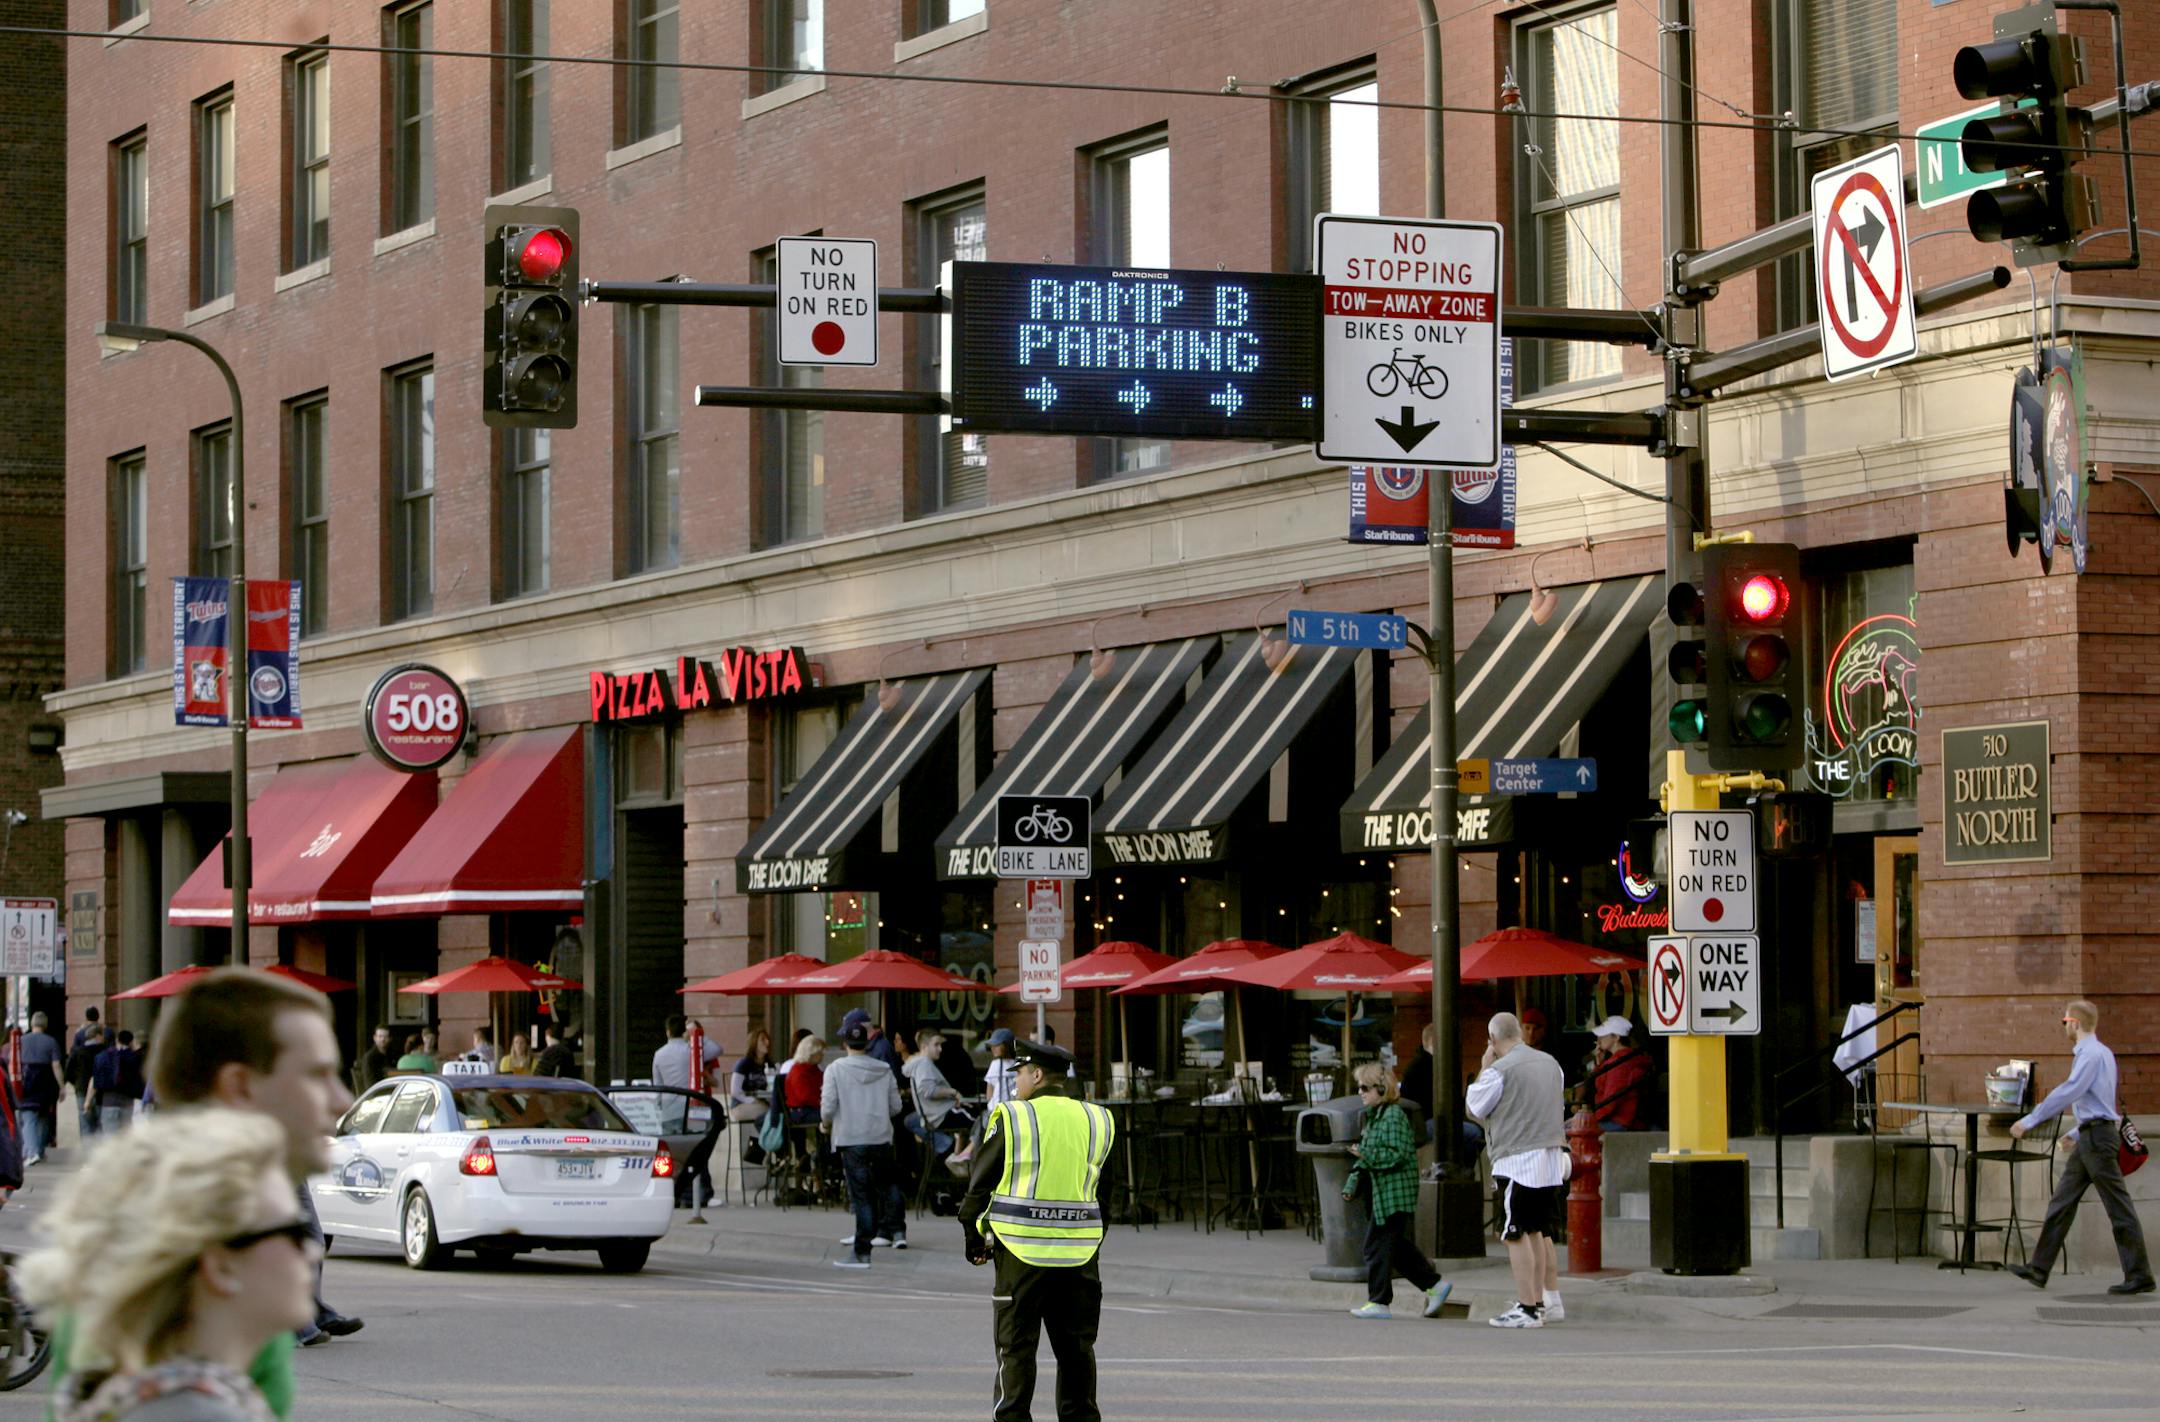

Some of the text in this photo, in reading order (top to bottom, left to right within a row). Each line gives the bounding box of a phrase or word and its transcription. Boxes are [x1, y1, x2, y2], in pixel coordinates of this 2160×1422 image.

[1927, 143, 1943, 184] N
[1393, 232, 1426, 255] NO
[811, 247, 843, 266] NO
[800, 272, 855, 291] TURN
[1112, 271, 1169, 280] DAKTRONICS
[1346, 258, 1473, 285] STOPPING
[788, 296, 868, 316] ON RED
[1031, 279, 1249, 326] RAMP B
[1440, 296, 1486, 317] ZONE
[1345, 321, 1467, 344] BIKES ONLY
[1019, 324, 1260, 373] PARKING
[1502, 447, 1515, 523] ERRITORY
[1352, 482, 1366, 517] THIS
[1364, 529, 1415, 542] StarTribune
[1453, 533, 1501, 544] StarTribune
[1293, 617, 1400, 642] N 5th St
[409, 681, 430, 690] bar
[590, 646, 801, 723] PIZZA LA VISTA
[387, 693, 459, 732] 508
[388, 735, 454, 744] restaurant
[1869, 733, 1912, 759] LOON
[1983, 734, 2007, 758] 510
[1495, 762, 1538, 778] Target
[1815, 760, 1850, 781] THE
[1495, 777, 1543, 790] Center
[1953, 763, 2038, 803] BUTLER
[1364, 814, 1392, 847] THE
[1396, 811, 1432, 845] LOO
[1695, 820, 1729, 841] NO
[1956, 807, 2038, 846] NORTH
[1104, 830, 1213, 863] THE LOON CAFE
[948, 846, 998, 876] THE LOO
[1002, 852, 1085, 871] BIKE LANE
[1689, 849, 1736, 866] TURN
[748, 857, 829, 890] THE LOON CAFE
[1679, 875, 1747, 892] ON RED
[1597, 904, 1669, 933] Budweis
[1030, 949, 1049, 965] NO
[1700, 943, 1748, 965] ONE
[1023, 970, 1058, 982] PARKING
[1699, 970, 1749, 992] WAY
[453, 1064, 483, 1074] TAXI
[521, 1135, 532, 1145] &
[532, 1137, 562, 1145] White
[618, 1157, 653, 1169] 3117
[1029, 1207, 1088, 1222] TRAFFIC
